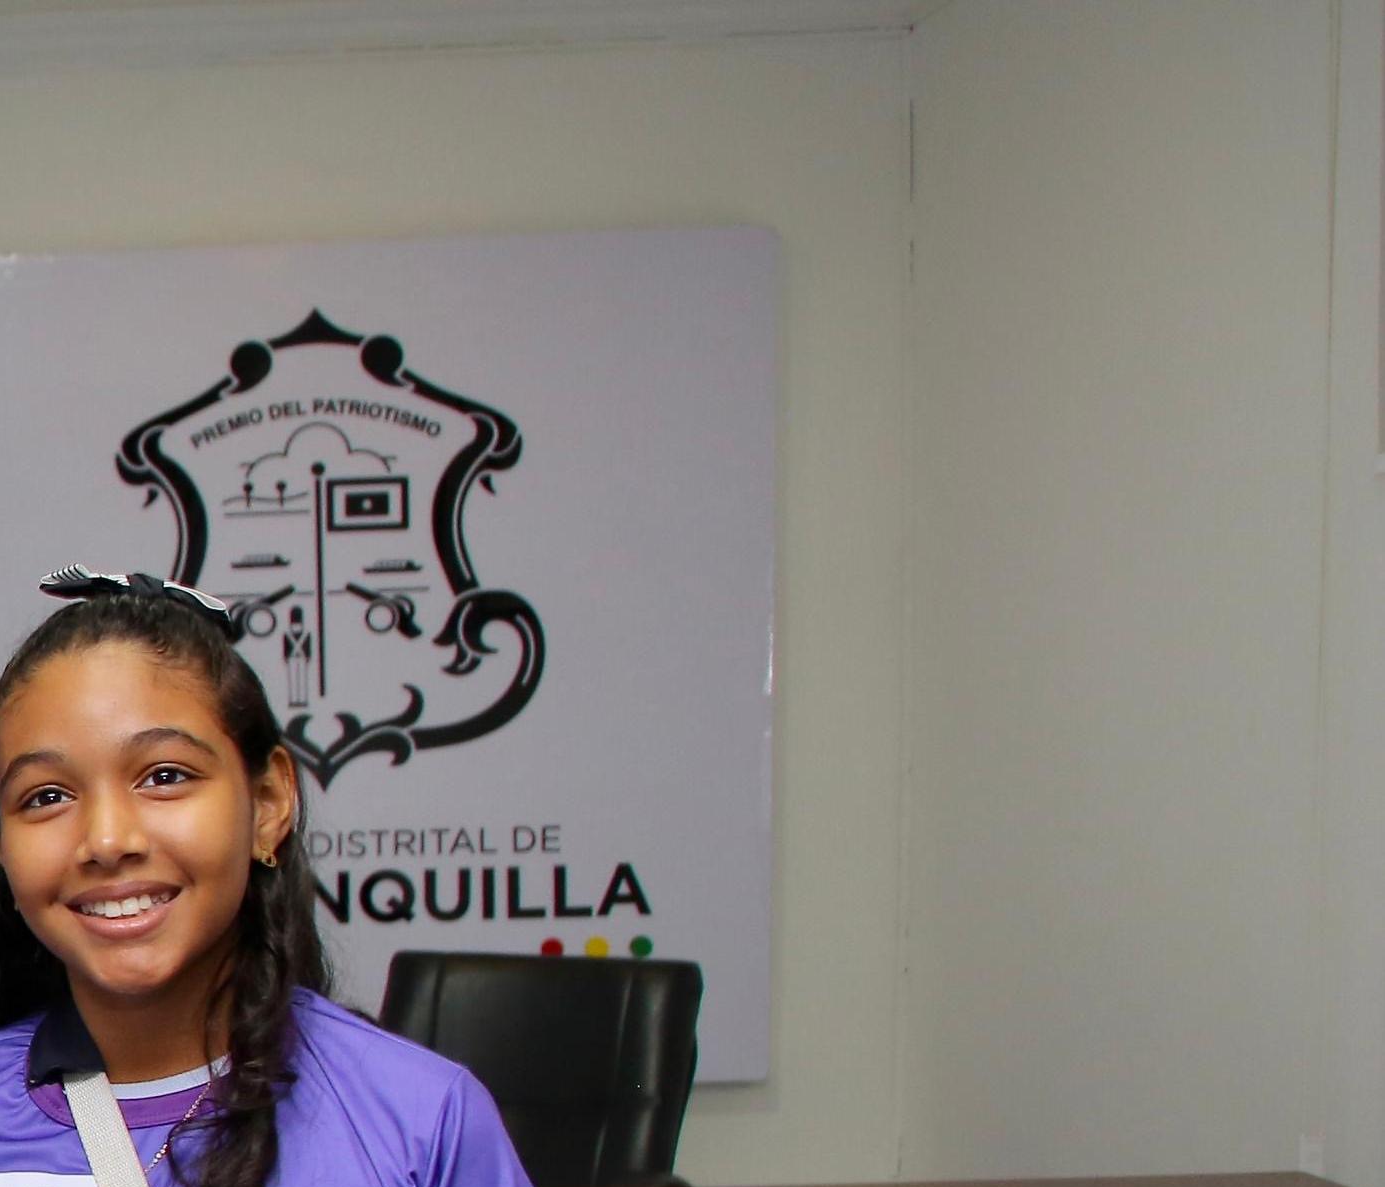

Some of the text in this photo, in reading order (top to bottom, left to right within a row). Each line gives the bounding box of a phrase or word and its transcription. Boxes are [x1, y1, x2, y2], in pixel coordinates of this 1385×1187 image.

[190, 399, 442, 449] PREMIO DEL PATRIOTISMO
[309, 825, 561, 858] DISTRITAL DE
[315, 863, 651, 924] NQUILLA
